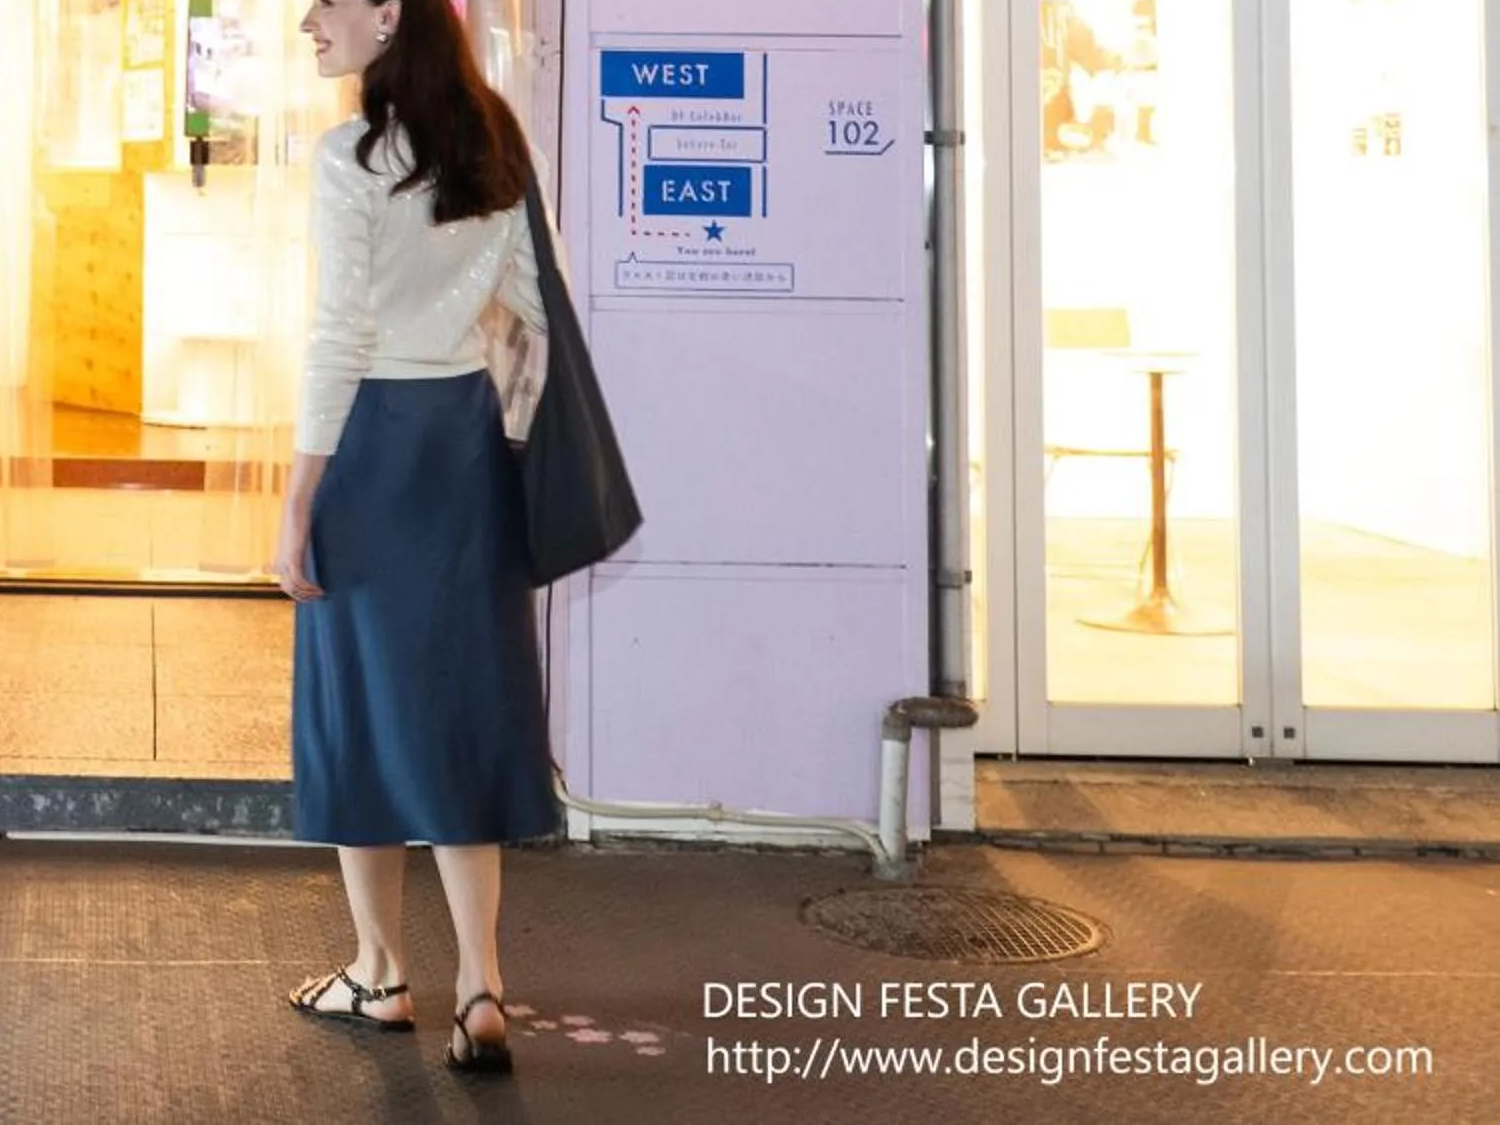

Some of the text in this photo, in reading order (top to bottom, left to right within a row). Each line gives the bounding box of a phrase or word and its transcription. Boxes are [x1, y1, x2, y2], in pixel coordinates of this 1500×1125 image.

[631, 63, 709, 86] WEST
[828, 100, 874, 116] SPACE
[828, 120, 880, 146] 102
[661, 179, 732, 203] EAST
